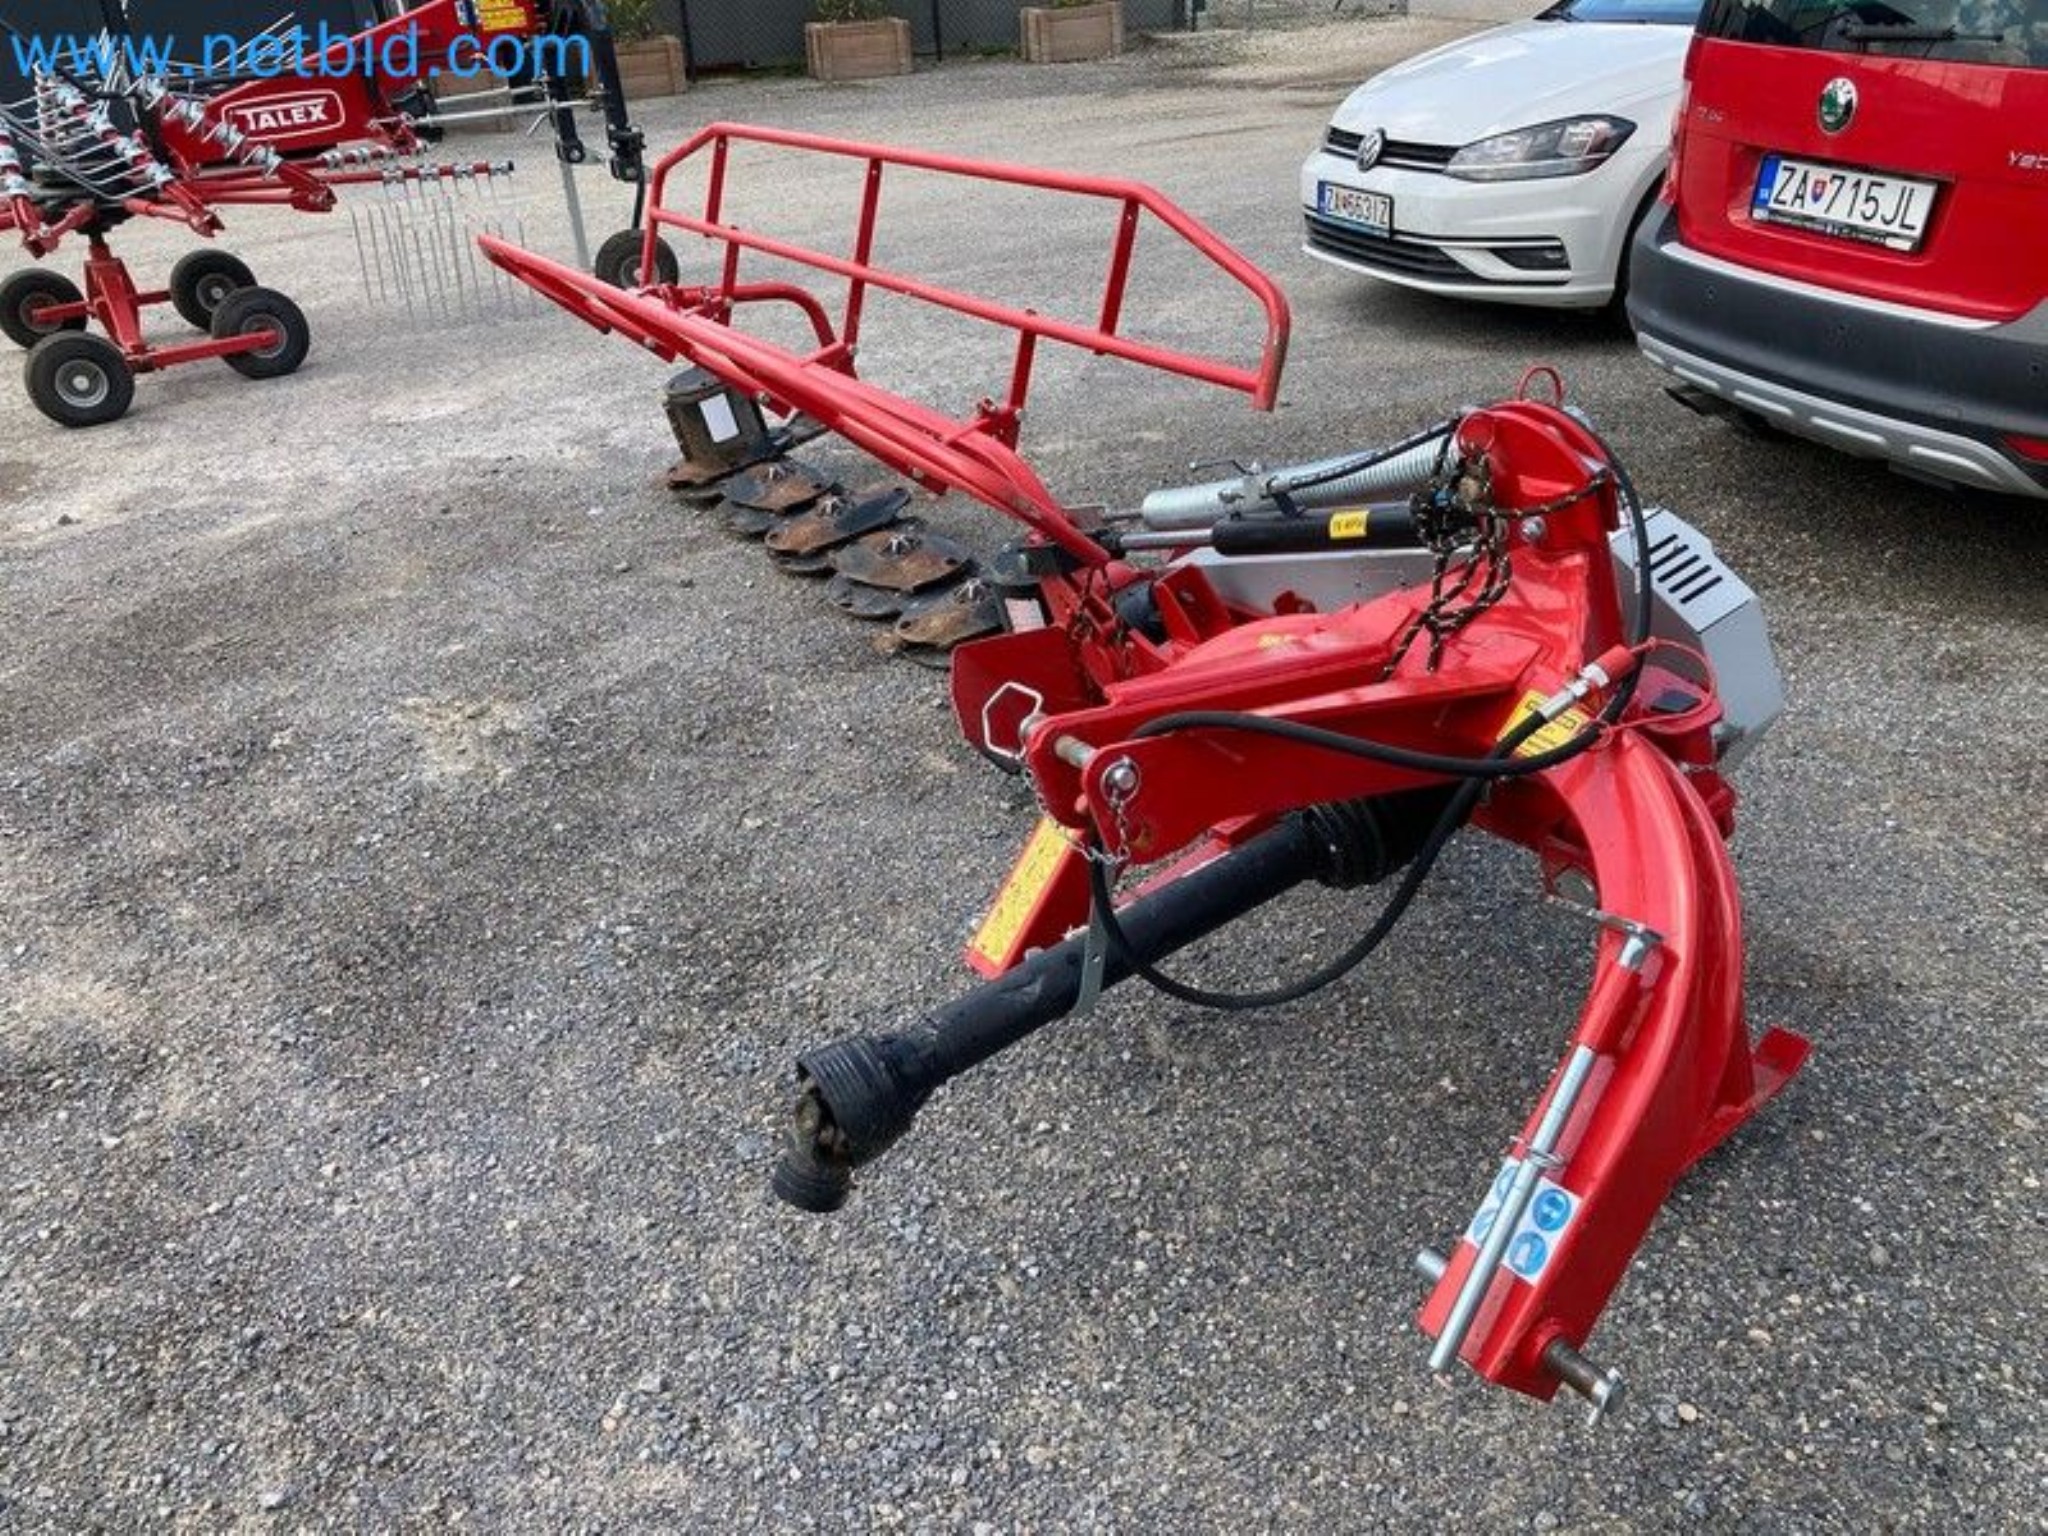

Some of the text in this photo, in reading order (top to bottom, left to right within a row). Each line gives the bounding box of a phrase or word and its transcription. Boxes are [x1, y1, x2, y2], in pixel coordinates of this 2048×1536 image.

[232, 97, 328, 131] TALEX
[1771, 165, 1810, 209] ZA
[1824, 173, 1917, 231] 715JL
